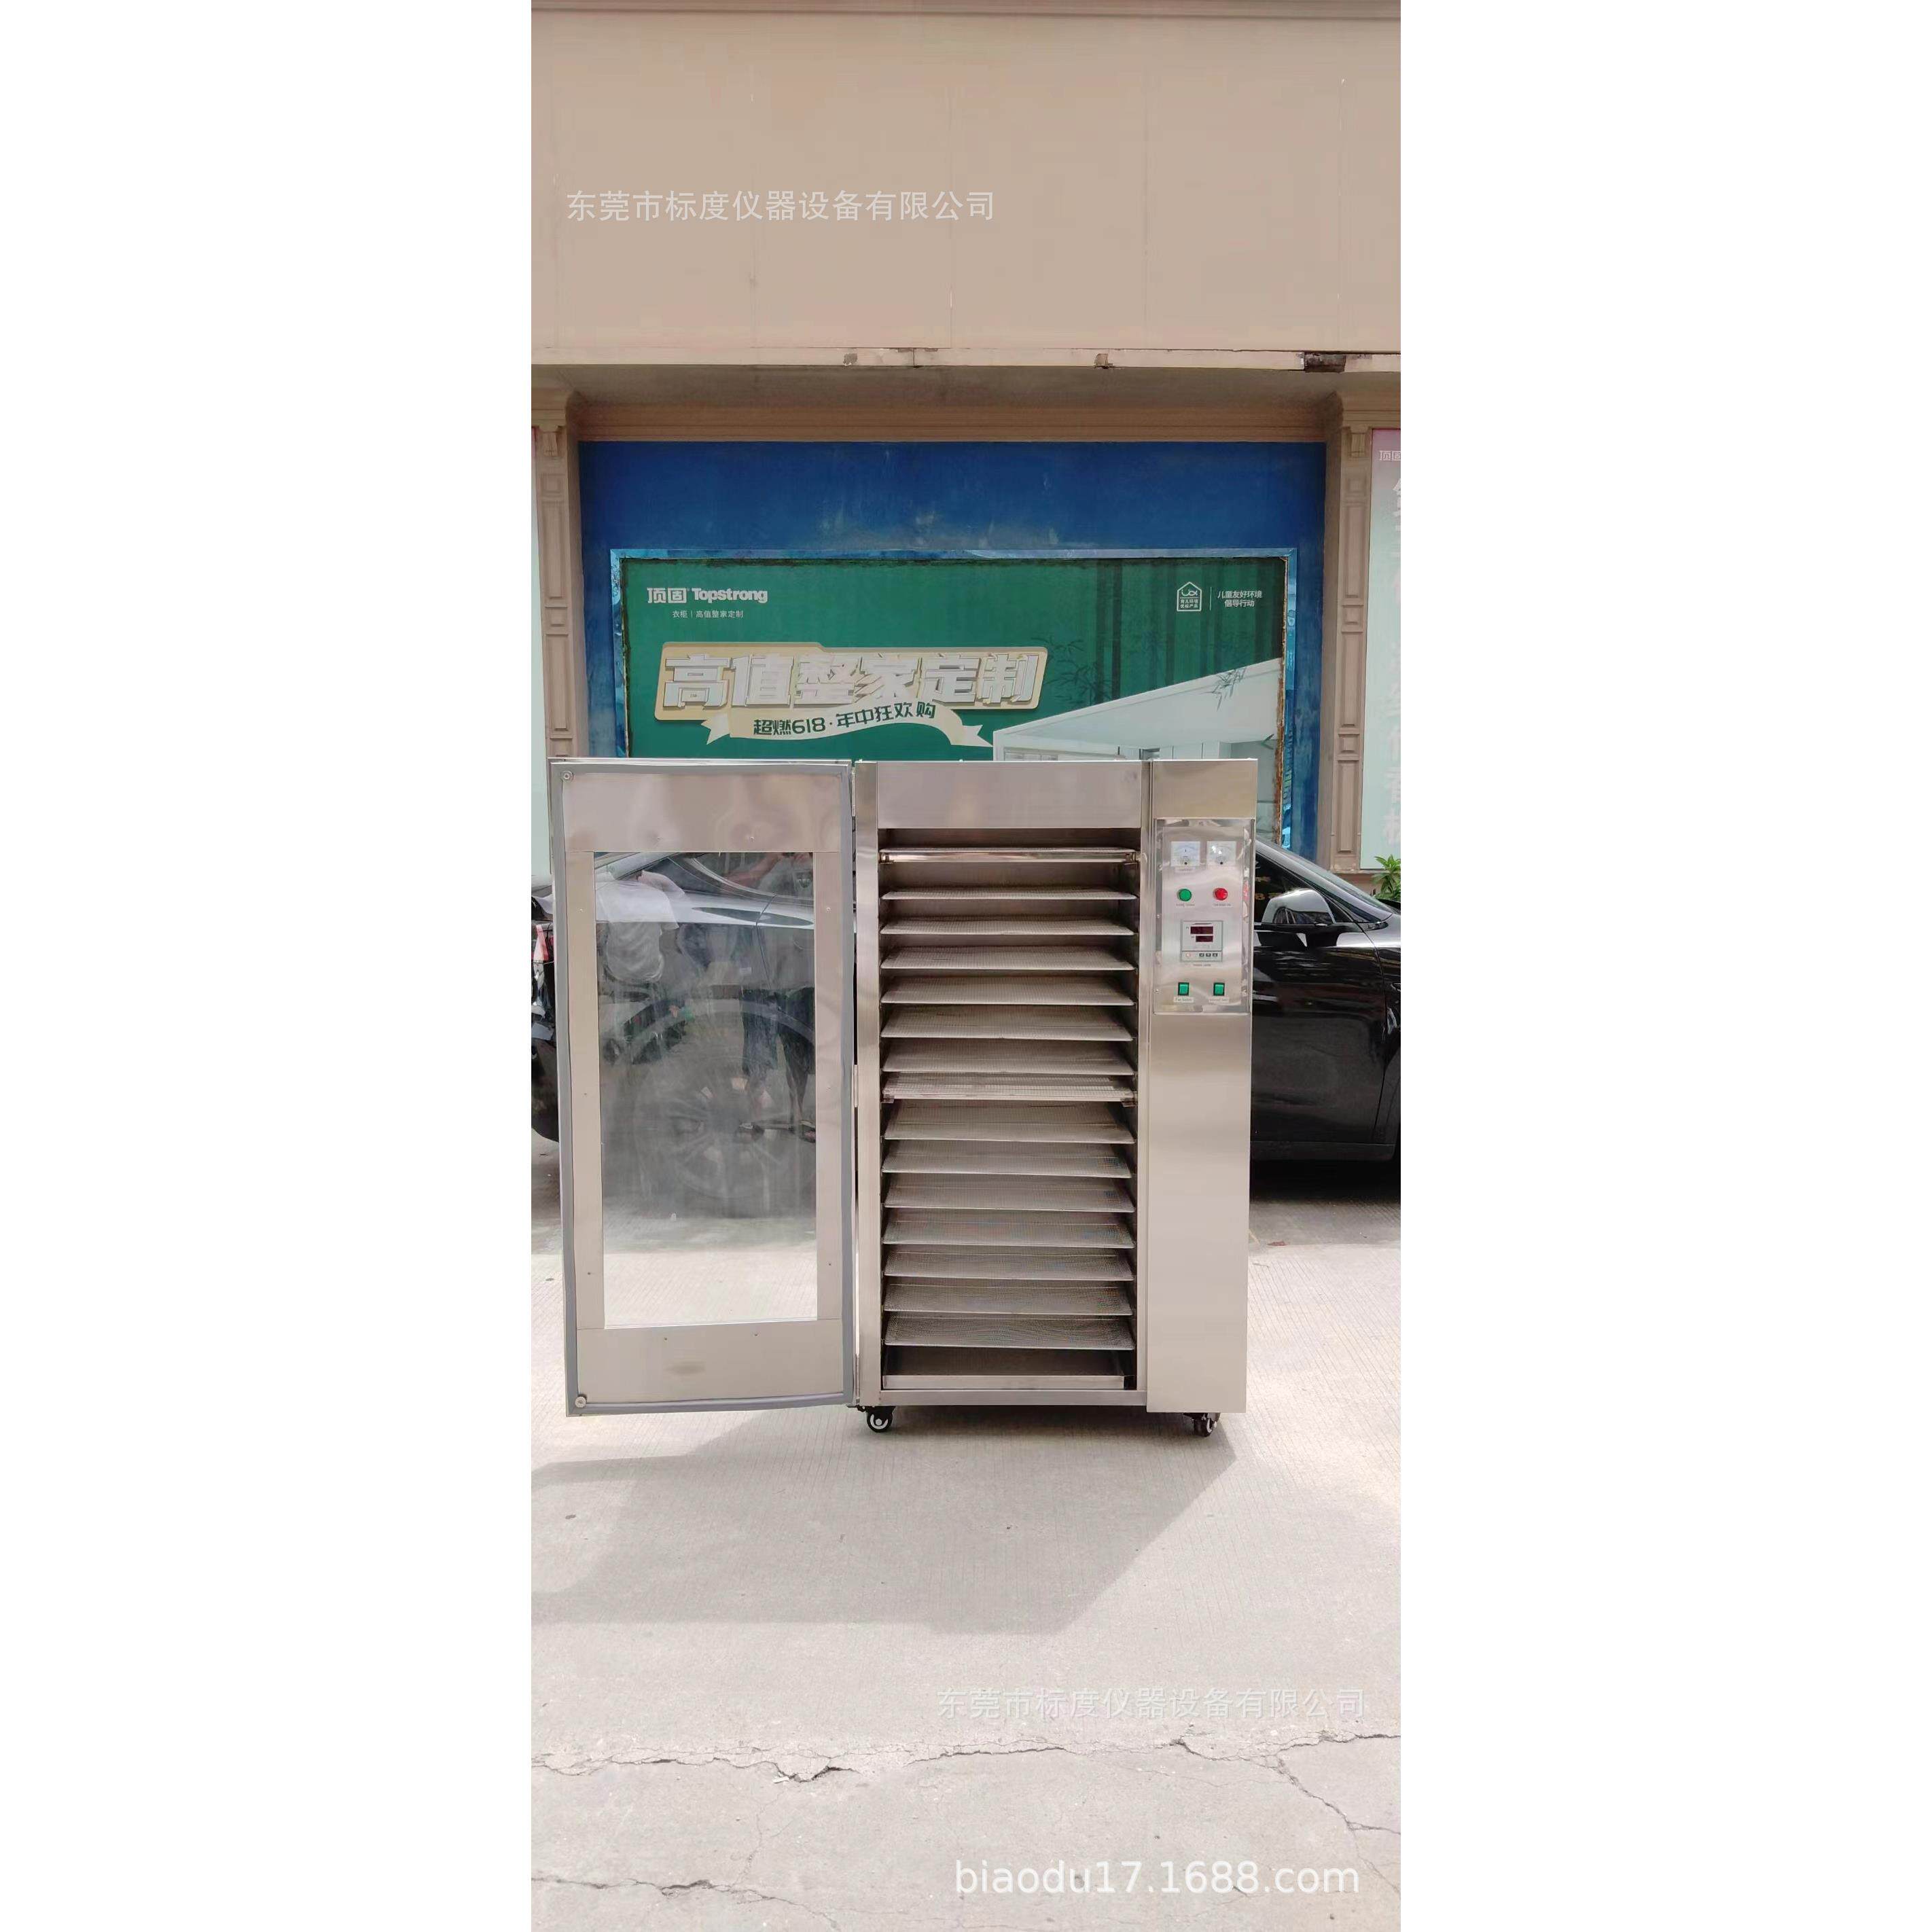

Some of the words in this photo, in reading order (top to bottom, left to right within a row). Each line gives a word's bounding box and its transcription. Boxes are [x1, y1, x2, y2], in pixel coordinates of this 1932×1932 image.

[647, 588, 687, 603] 顶固
[692, 588, 768, 603] Topstrong
[1217, 590, 1262, 598] 儿童友好环境
[1224, 599, 1255, 607] 倡导行动
[672, 610, 688, 618] 衣柜
[696, 610, 744, 618] 高值整家定制
[662, 654, 1038, 709] 高值整家定制
